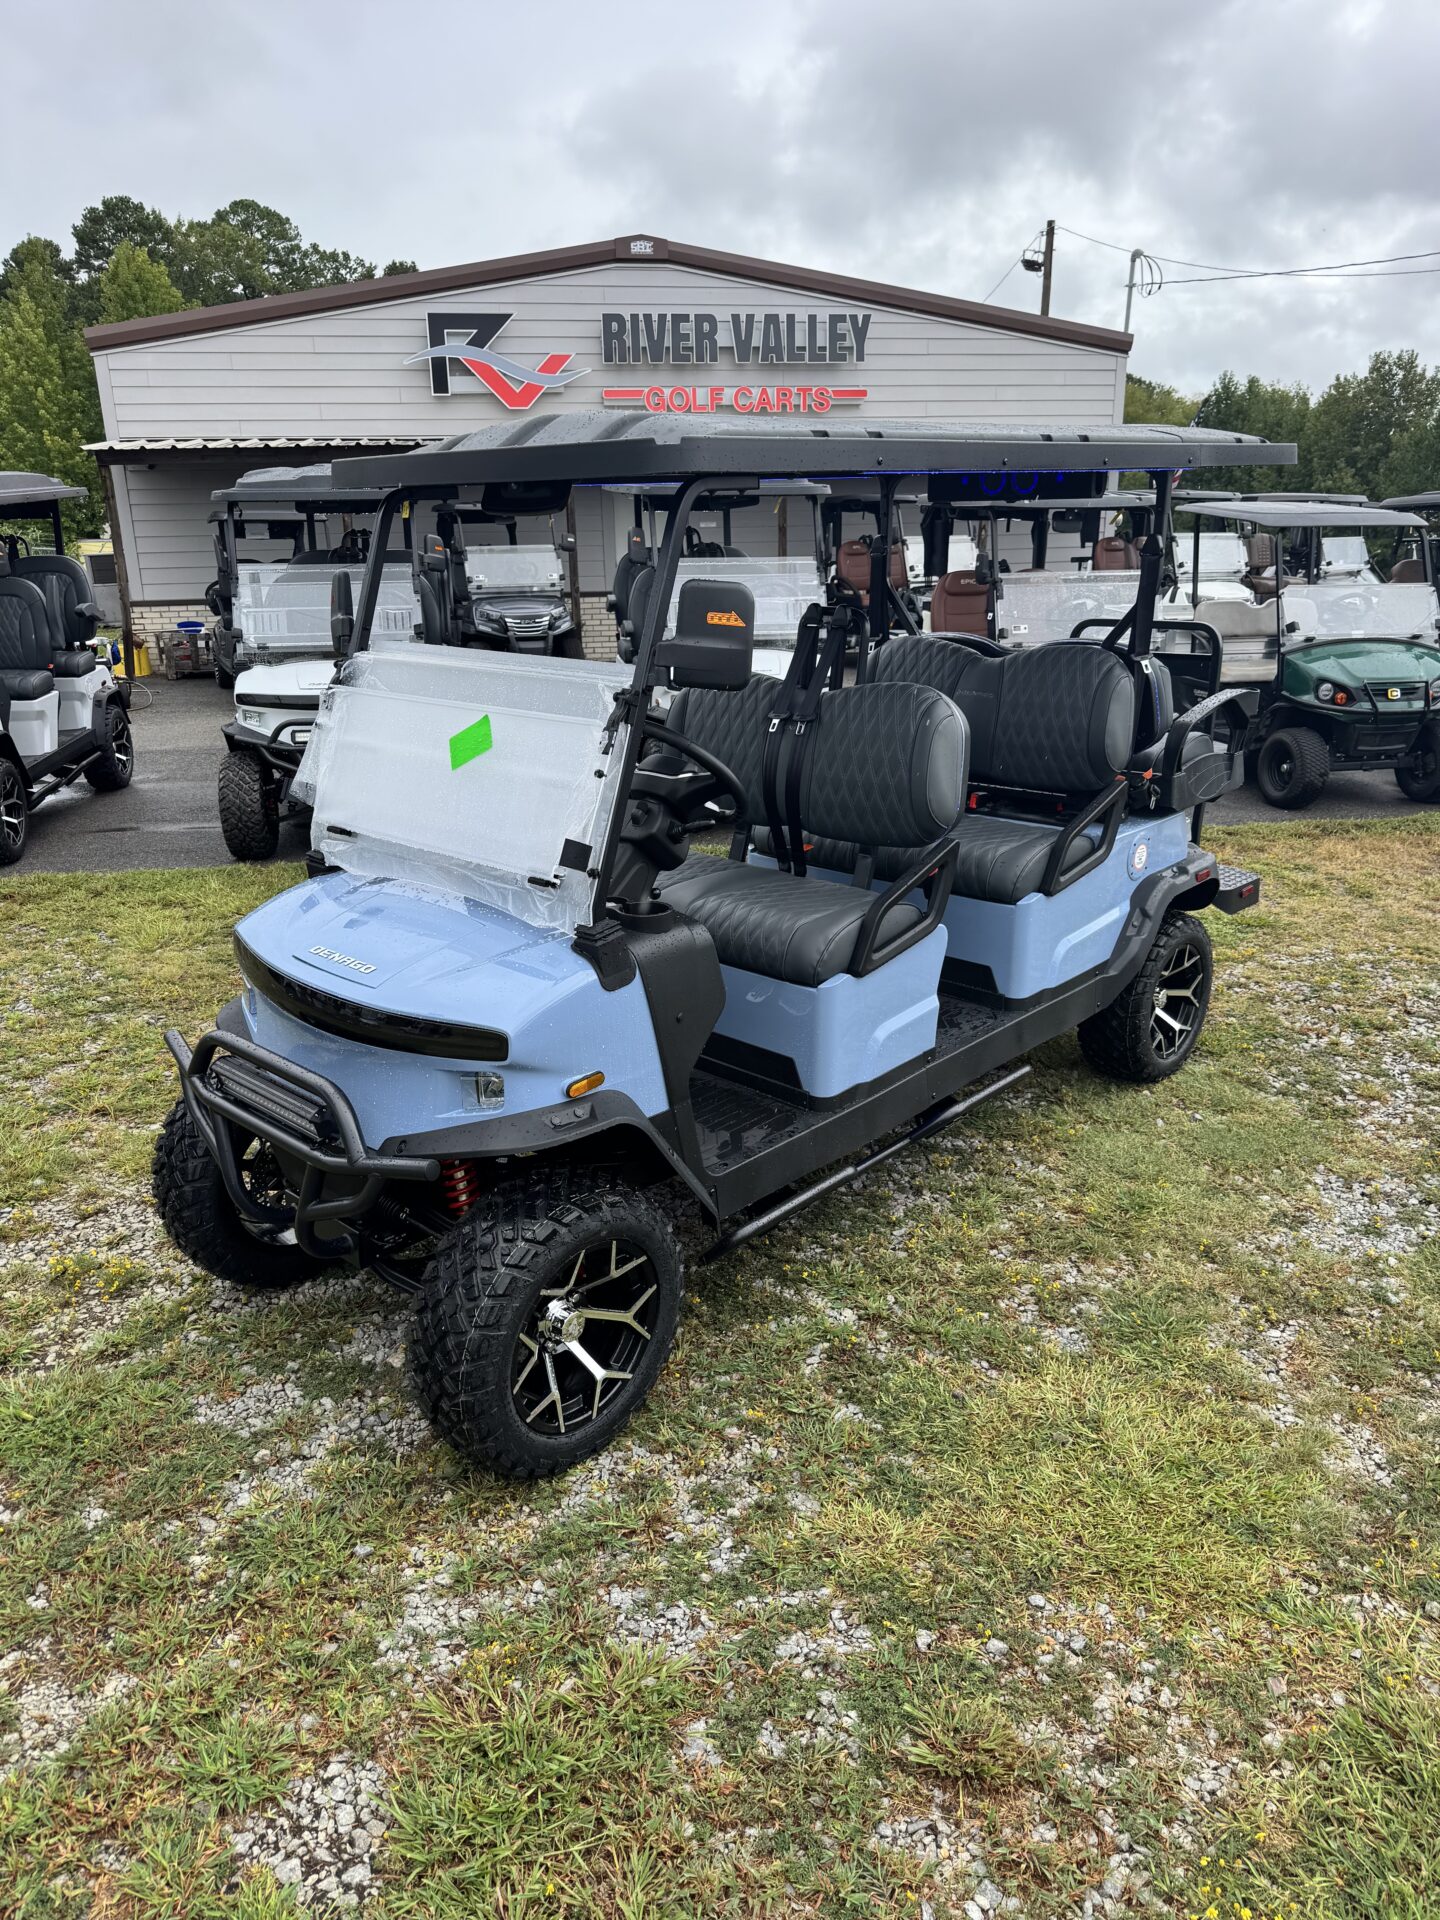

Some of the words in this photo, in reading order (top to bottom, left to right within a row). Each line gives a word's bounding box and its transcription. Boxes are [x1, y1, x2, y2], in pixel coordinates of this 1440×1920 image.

[601, 312, 720, 364] RIVER
[730, 312, 872, 364] VALLEY
[644, 385, 725, 413] GOLF
[732, 385, 832, 413] CARTS
[308, 945, 377, 974] DENAGO
